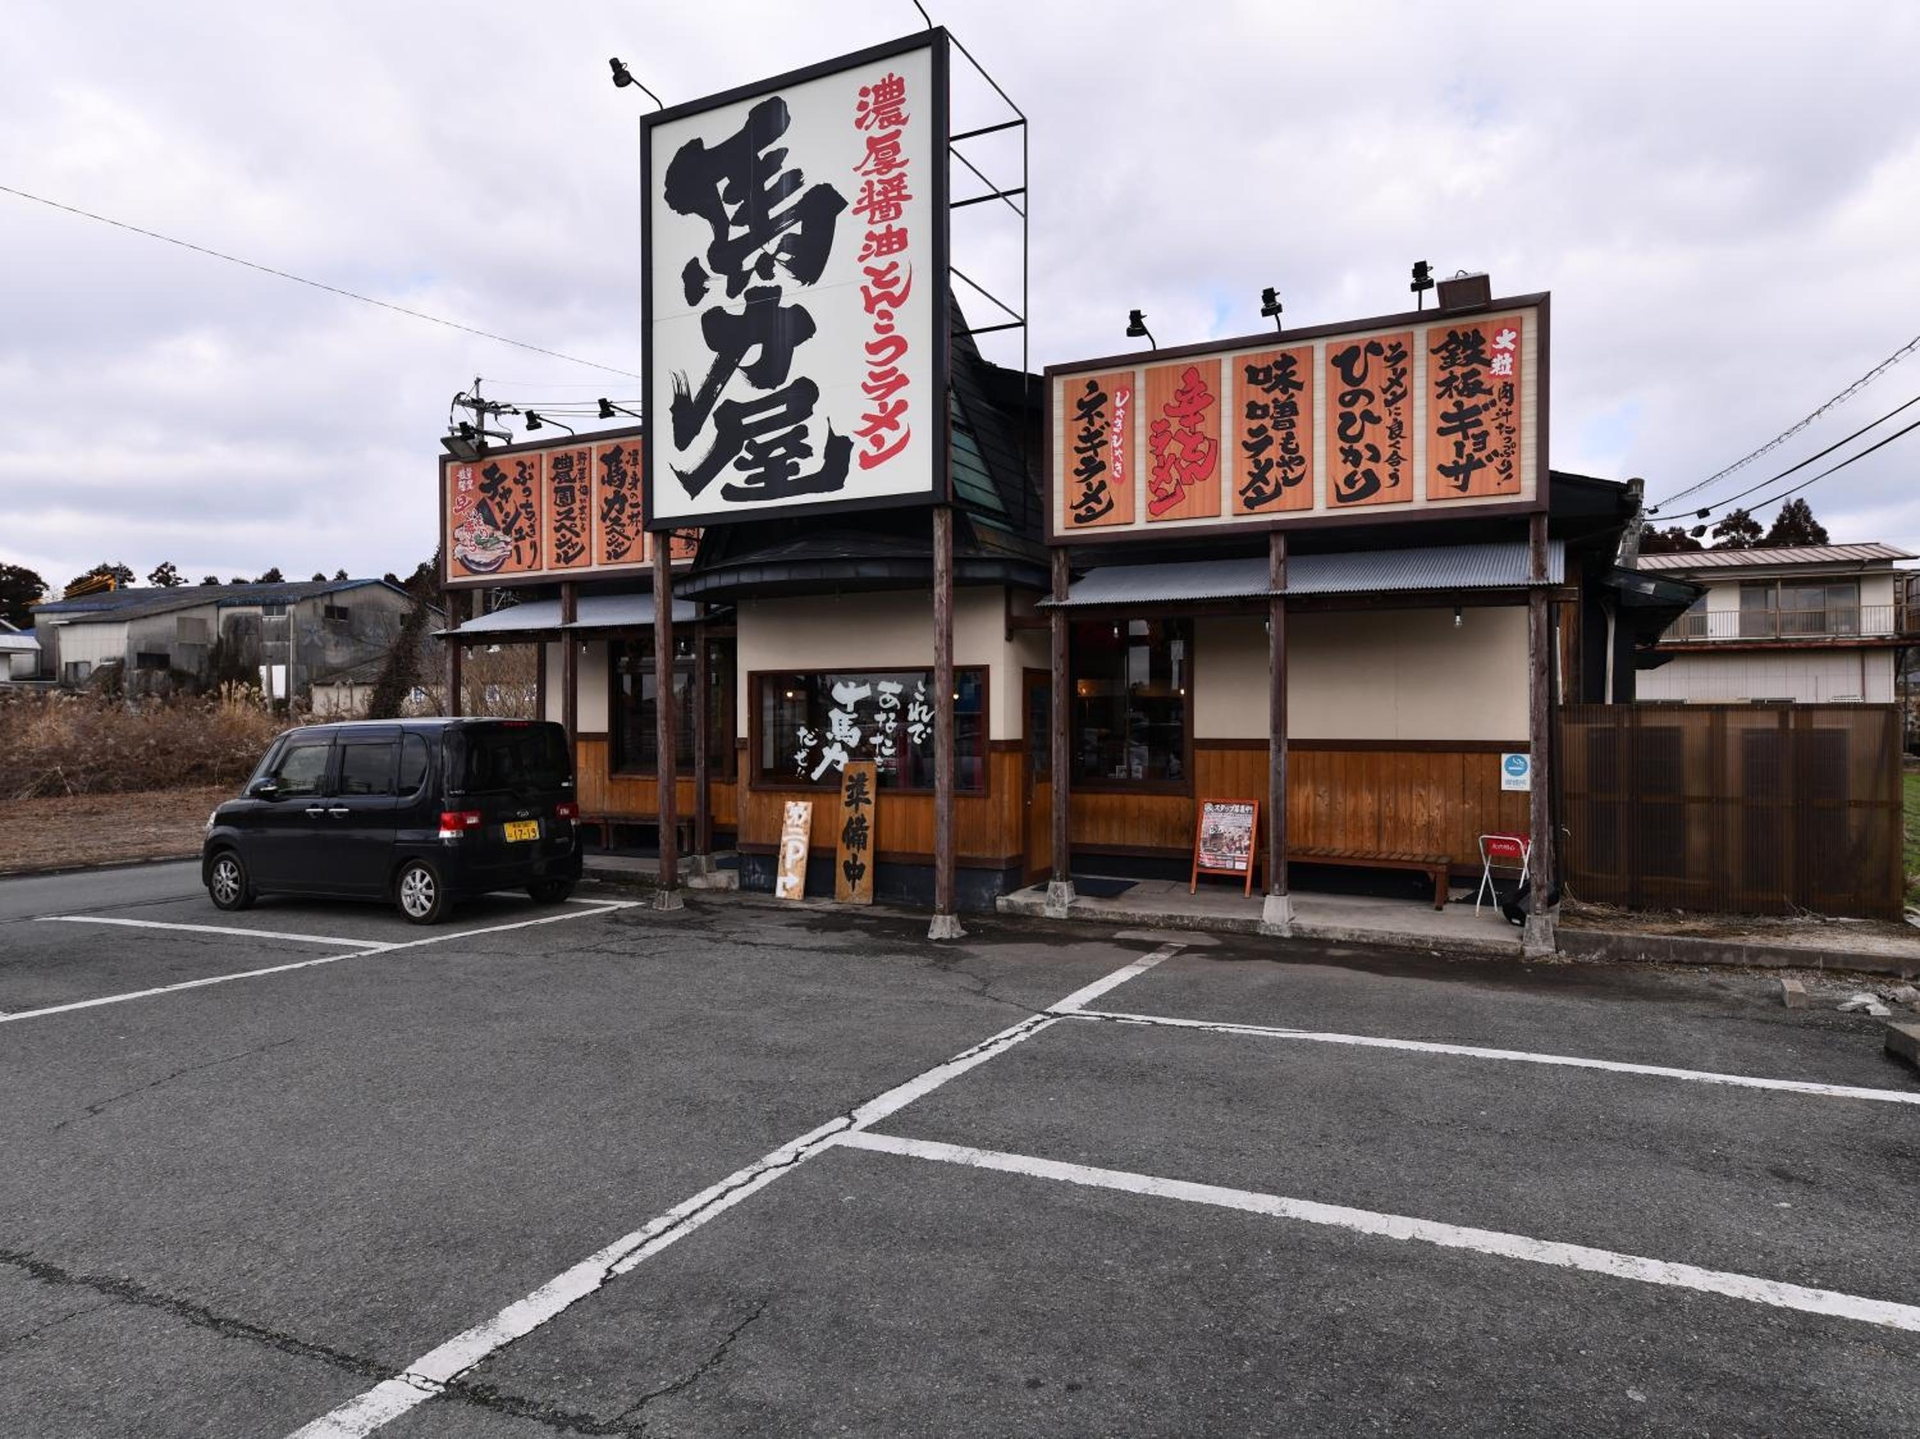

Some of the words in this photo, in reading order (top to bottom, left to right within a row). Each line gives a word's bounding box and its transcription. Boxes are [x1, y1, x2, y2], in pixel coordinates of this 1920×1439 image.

[664, 95, 854, 502] 馬力屋
[852, 72, 913, 471] 濃厚醤油とんこつラーメン
[1331, 340, 1386, 503] ひのひかり
[907, 680, 936, 745] これで
[842, 772, 873, 892] 準備中
